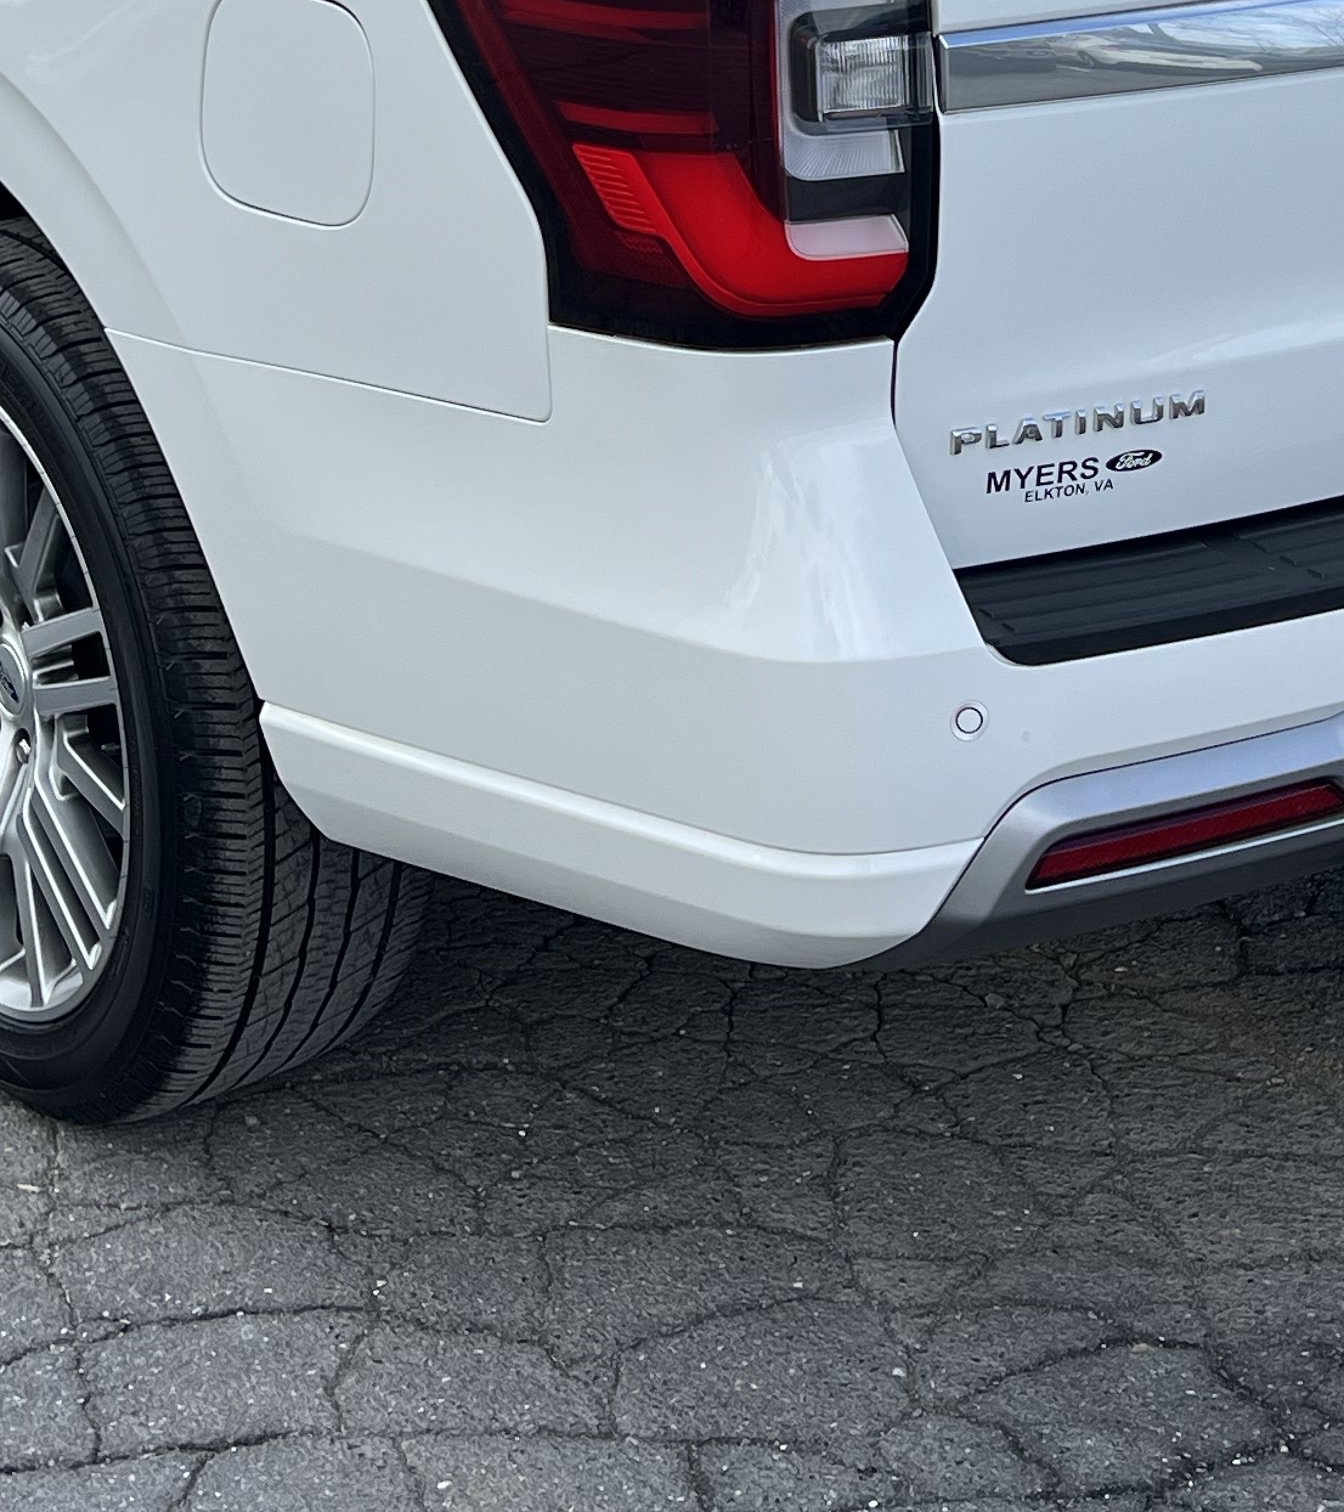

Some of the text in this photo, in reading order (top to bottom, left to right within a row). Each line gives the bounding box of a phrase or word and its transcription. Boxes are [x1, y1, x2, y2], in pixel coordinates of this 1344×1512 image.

[949, 389, 1206, 456] PLATINUM
[985, 450, 1153, 495] MYERS Ford
[1023, 478, 1115, 503] ELKTON, VA
